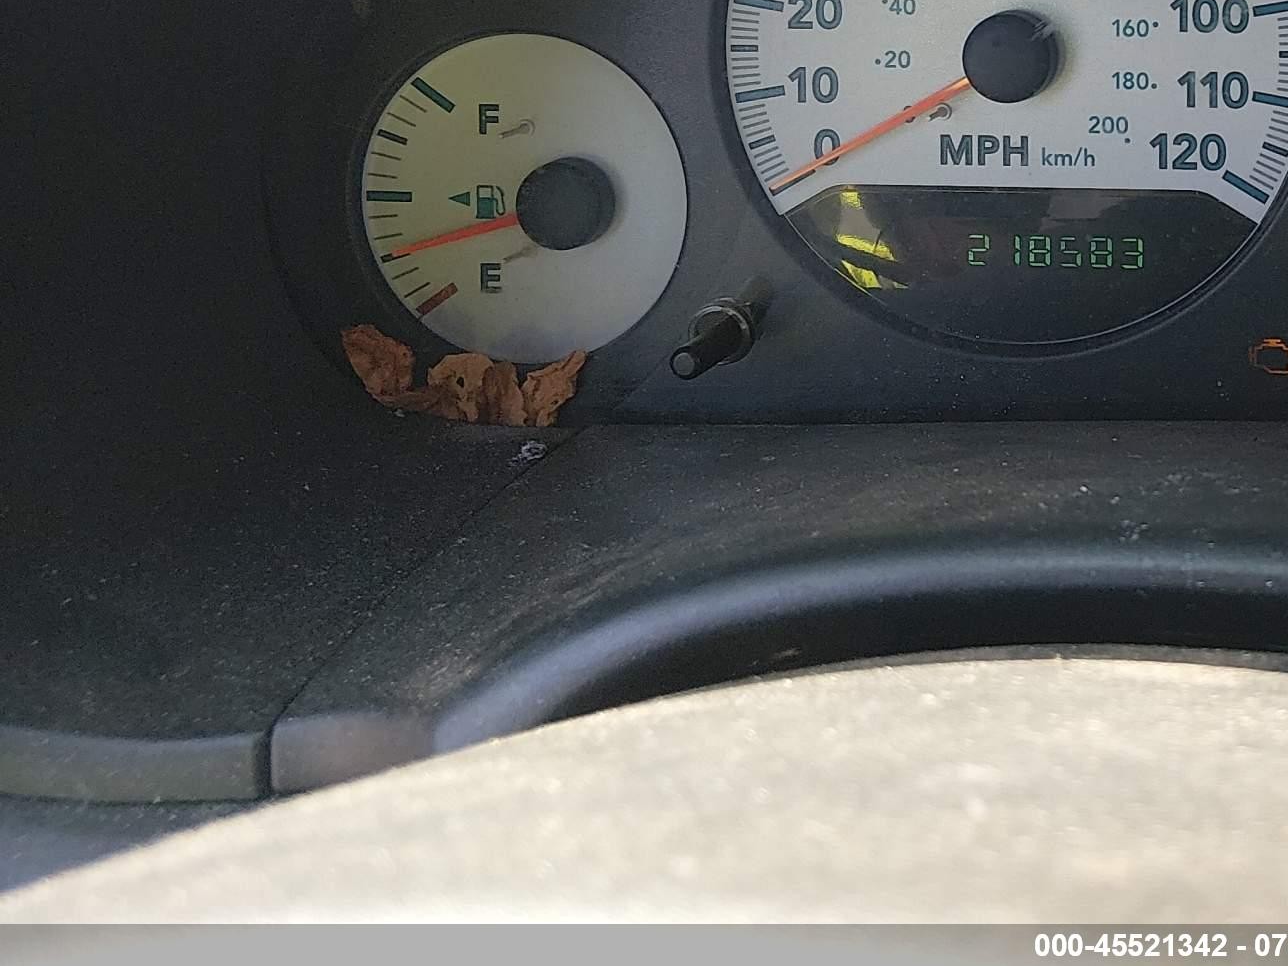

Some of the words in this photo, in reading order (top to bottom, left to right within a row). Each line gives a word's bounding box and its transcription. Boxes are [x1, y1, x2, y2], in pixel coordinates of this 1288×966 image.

[1112, 20, 1150, 38] 160
[885, 51, 911, 69] 20
[788, 67, 838, 103] 10
[1112, 73, 1150, 90] 180
[1177, 71, 1249, 109] 110
[478, 104, 500, 135] F
[1089, 116, 1128, 134] 200
[814, 129, 841, 165] 0
[940, 134, 1028, 166] MPH
[1042, 147, 1095, 166] km/h
[1149, 133, 1226, 171] 120
[968, 234, 1145, 269] 218583
[480, 263, 501, 293] E
